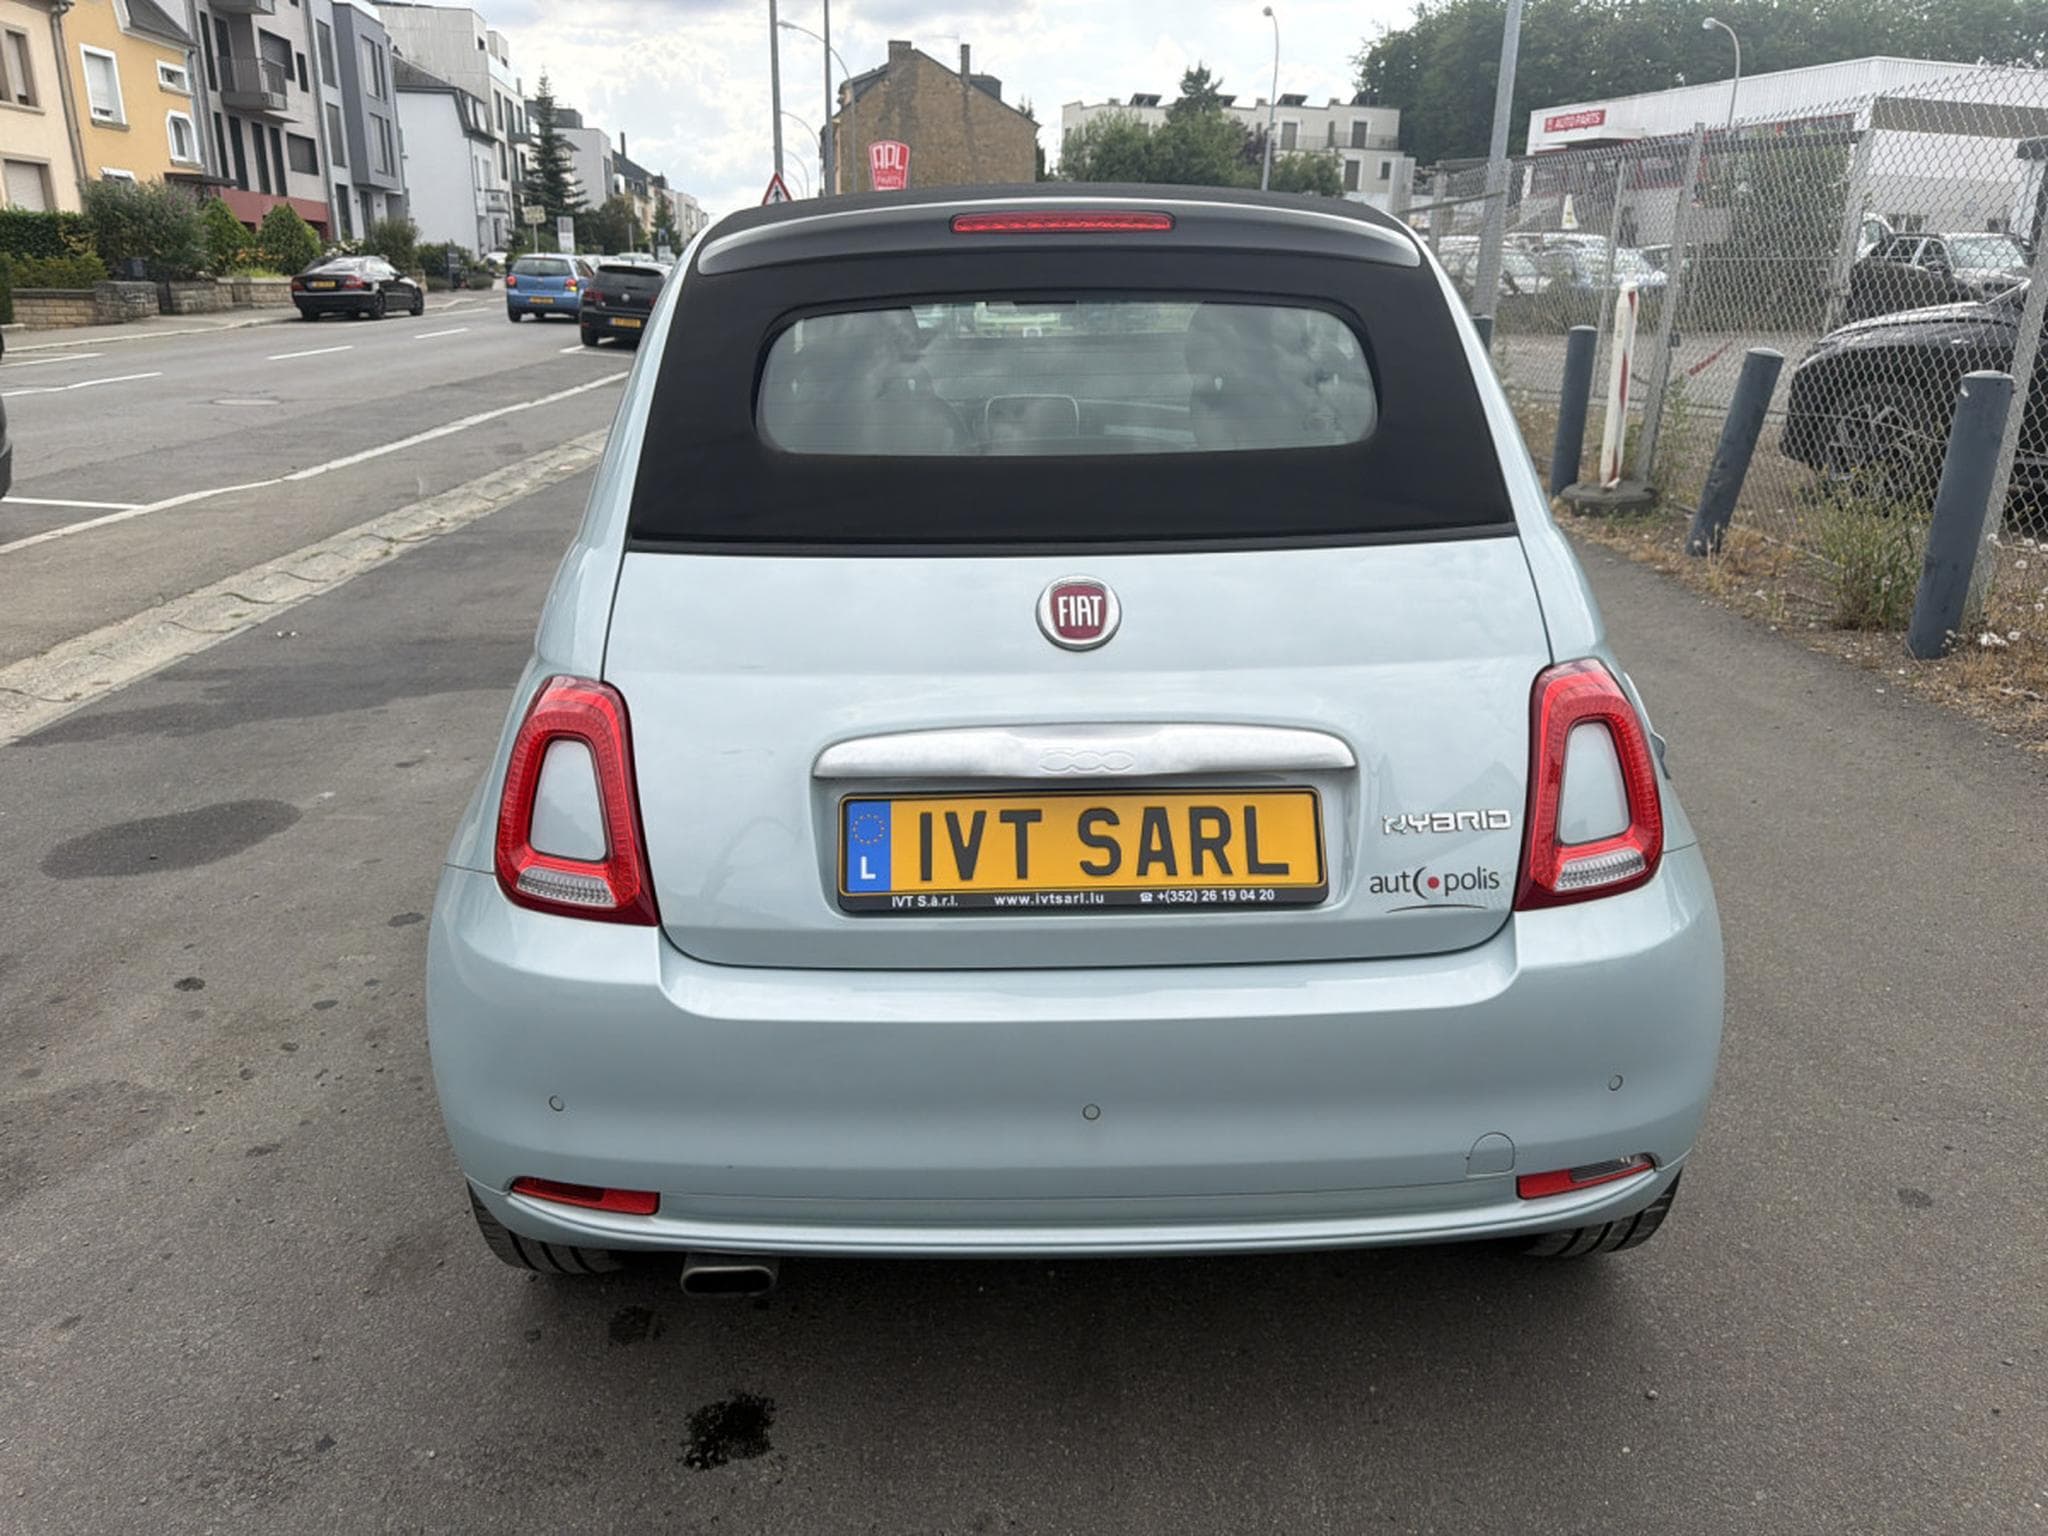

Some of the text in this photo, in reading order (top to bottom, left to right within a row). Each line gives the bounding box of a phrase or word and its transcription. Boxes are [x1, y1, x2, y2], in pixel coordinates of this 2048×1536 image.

[1057, 595, 1103, 627] FIAT
[1383, 809, 1511, 834] HYBRID
[919, 806, 1290, 882] IVT SARL
[860, 857, 876, 880] L
[892, 896, 914, 908] IVT
[994, 892, 1105, 906] www.ivtsarl.lu
[1157, 888, 1275, 904] +(352) 26 19 04 20
